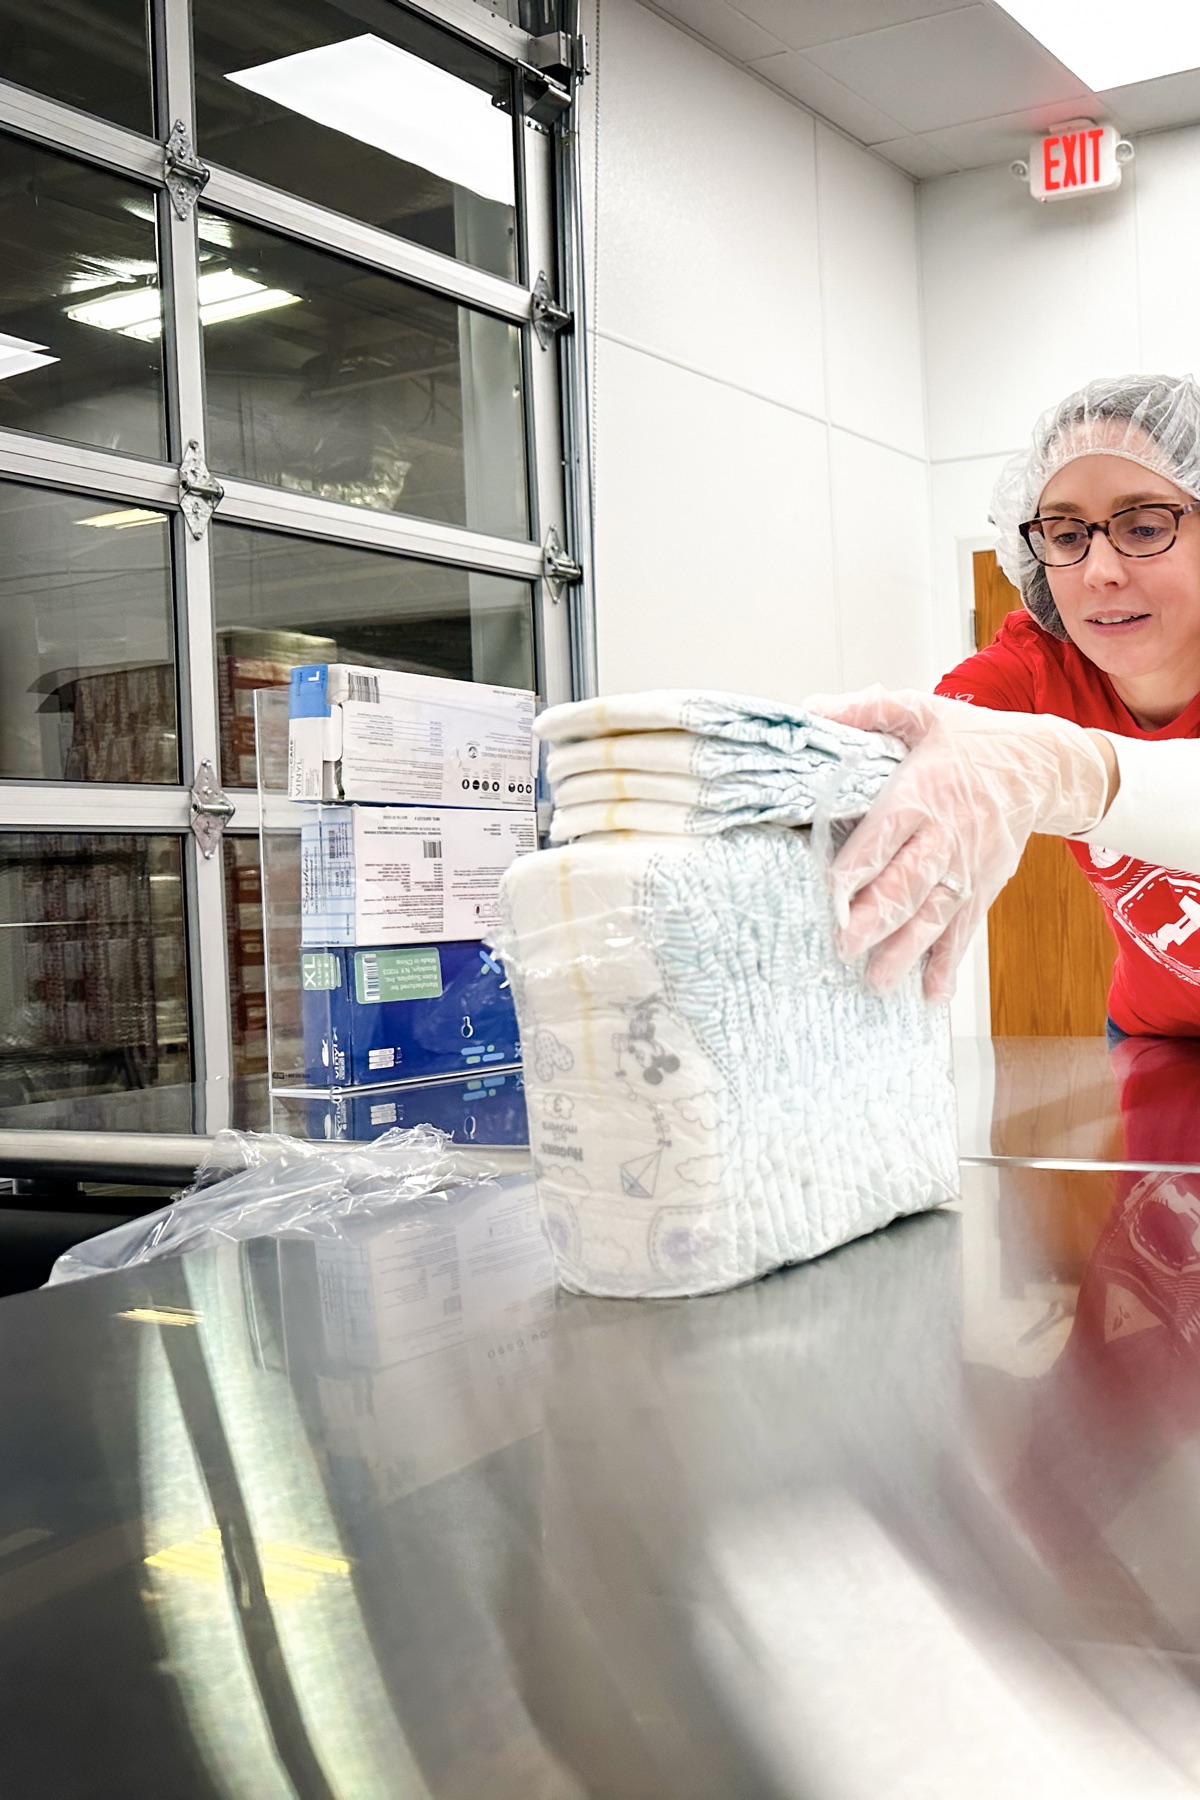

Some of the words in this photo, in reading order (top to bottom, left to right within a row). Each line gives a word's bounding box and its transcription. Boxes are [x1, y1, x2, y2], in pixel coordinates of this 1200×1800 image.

[1043, 128, 1104, 191] EXIT
[308, 670, 320, 682] L
[304, 956, 316, 987] XL
[554, 1095, 562, 1112] 3
[542, 1122, 577, 1133] movers
